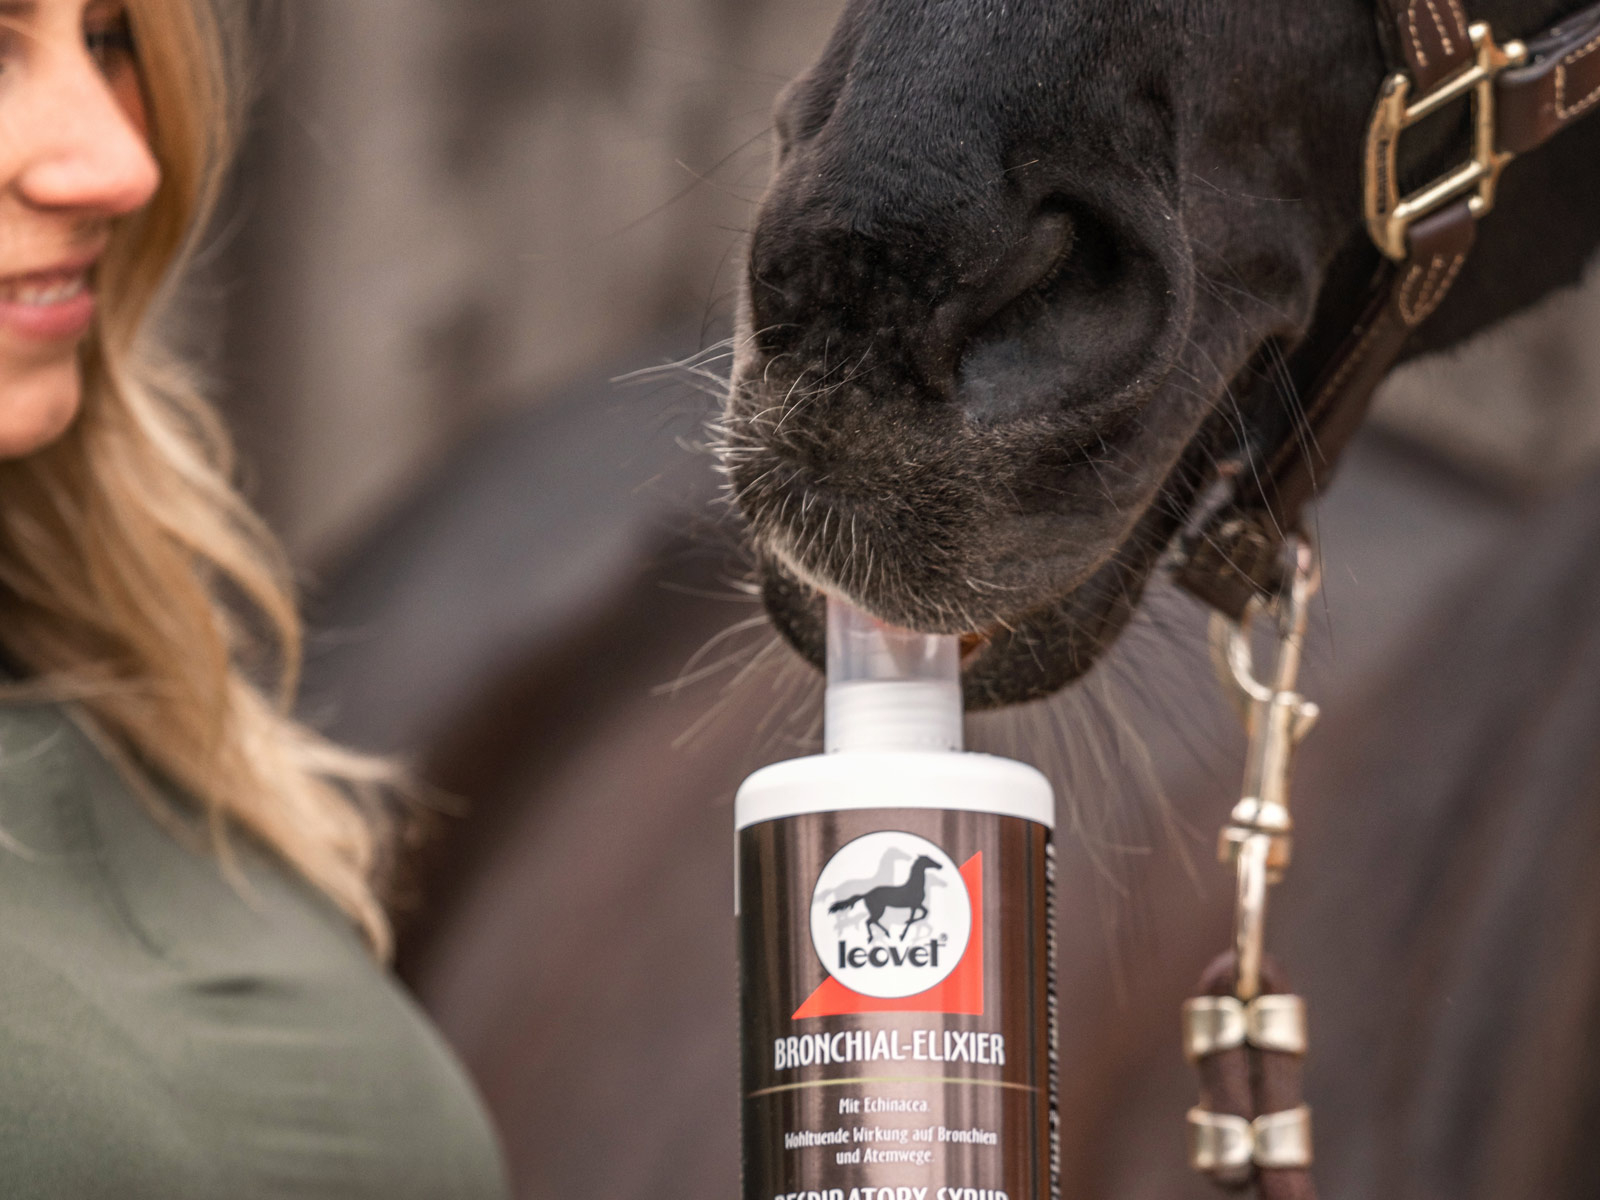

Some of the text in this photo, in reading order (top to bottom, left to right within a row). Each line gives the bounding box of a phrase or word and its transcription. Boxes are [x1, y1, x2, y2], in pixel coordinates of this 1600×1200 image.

[774, 1030, 1005, 1070] BRONCHIAL-ELIXIER
[839, 1097, 860, 1115] Mit
[785, 1125, 998, 1149] Wohltuende Wirkung auf Bronchien
[836, 1147, 860, 1165] und
